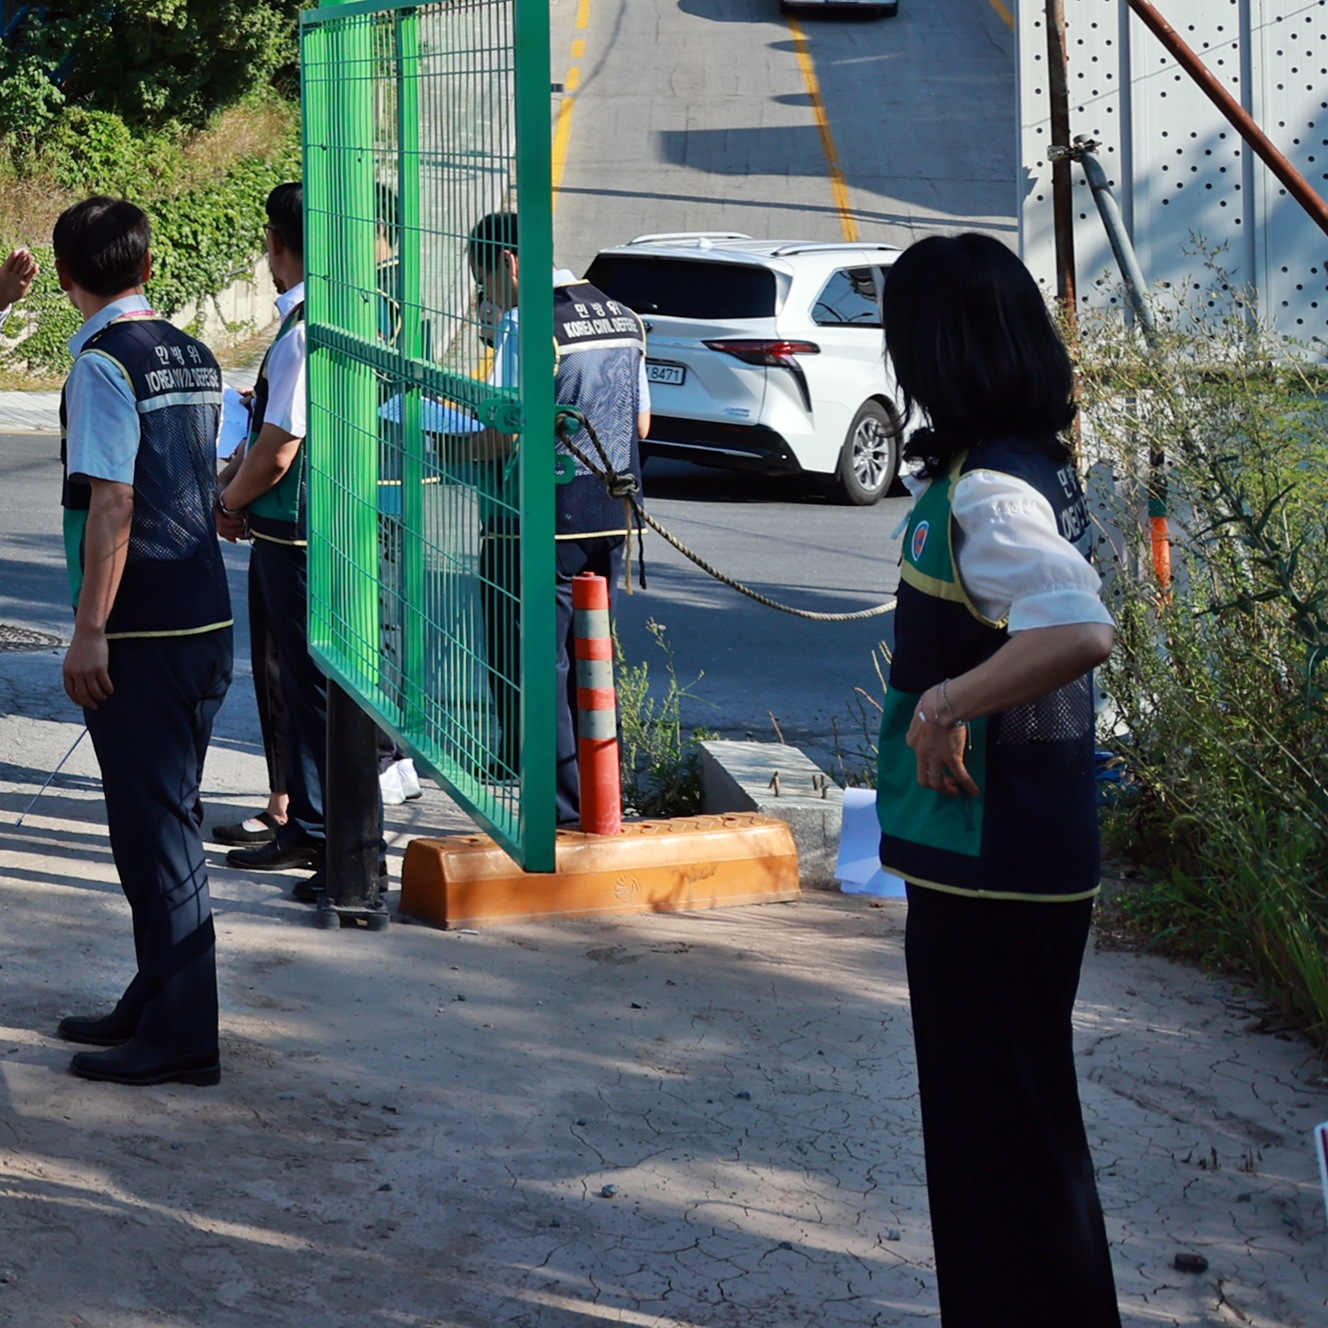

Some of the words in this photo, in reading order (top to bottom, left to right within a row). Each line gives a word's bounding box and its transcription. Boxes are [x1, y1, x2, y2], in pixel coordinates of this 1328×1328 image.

[574, 300, 622, 319] 민방위
[563, 320, 596, 338] KOREA
[592, 318, 615, 334] CIVIL
[154, 344, 202, 366] 민방위
[651, 367, 679, 382] 8471
